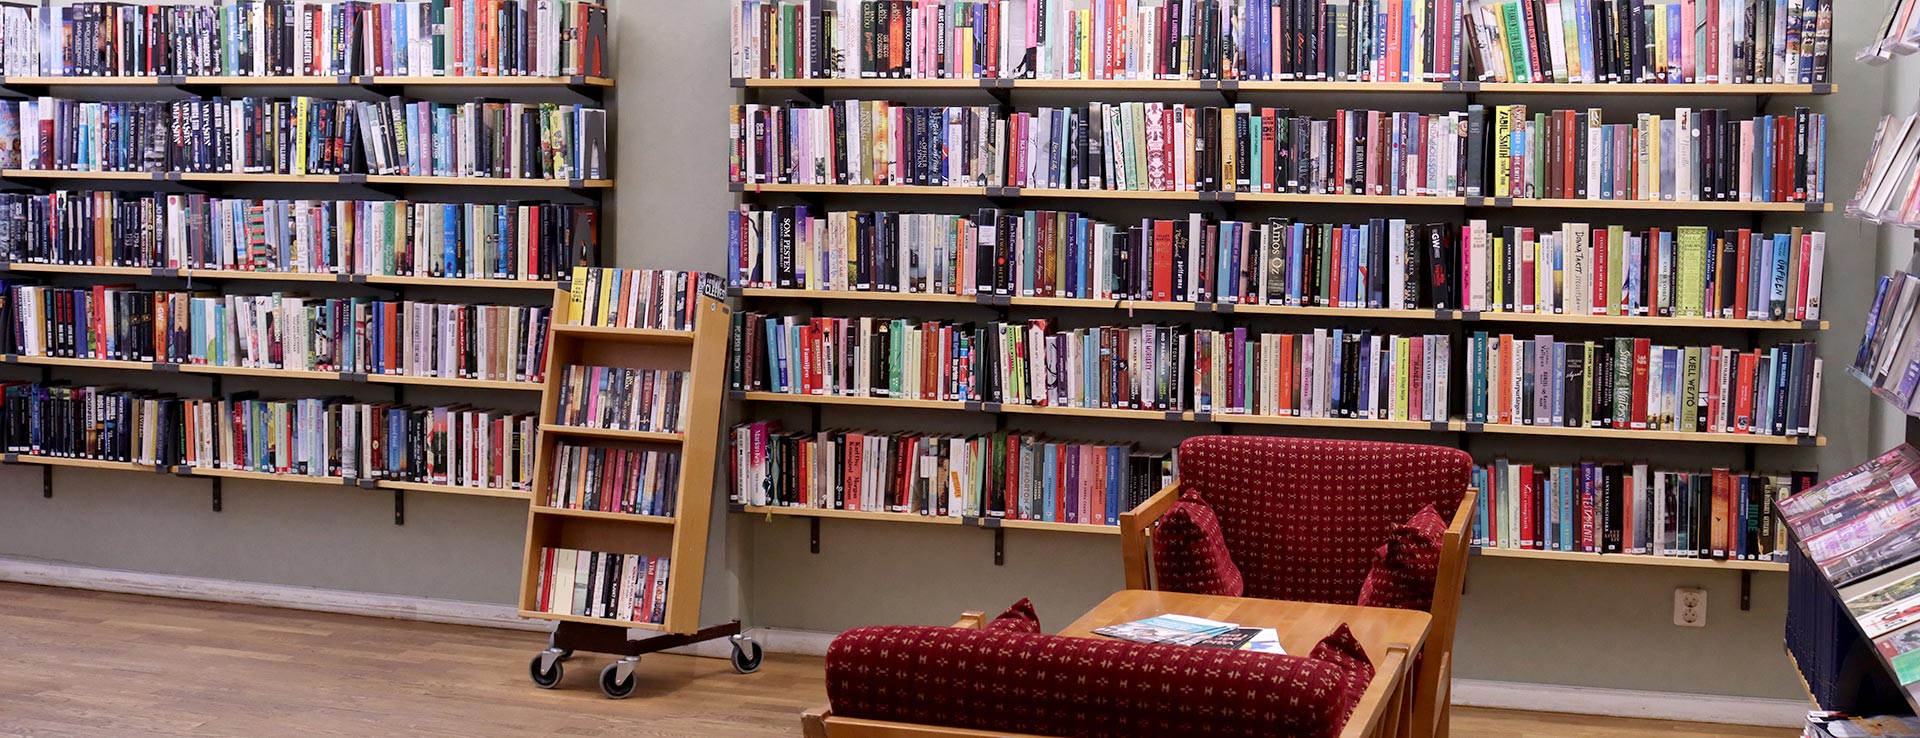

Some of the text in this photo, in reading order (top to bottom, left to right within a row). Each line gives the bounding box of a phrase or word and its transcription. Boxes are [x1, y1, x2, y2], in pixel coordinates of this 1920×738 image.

[304, 12, 312, 63] KARIN SLAUGHTER
[809, 16, 820, 63] Europa
[1500, 136, 1510, 158] SMITH
[1271, 221, 1283, 275] Amos Oz
[1431, 233, 1440, 248] GW
[1575, 232, 1583, 252] DONNA
[1575, 253, 1583, 273] TARTT
[1775, 260, 1785, 295] ÖRFILEN
[158, 307, 164, 321] GW
[1514, 377, 1522, 415] Purpurfärgen
[1618, 350, 1628, 418] Sarah Waters
[1686, 356, 1696, 407] KJELL WESTÖ
[1023, 472, 1031, 504] MORTON
[1583, 496, 1593, 542] TESTAMENTE
[1748, 504, 1758, 531] HILDE
[647, 560, 655, 575] Vild
